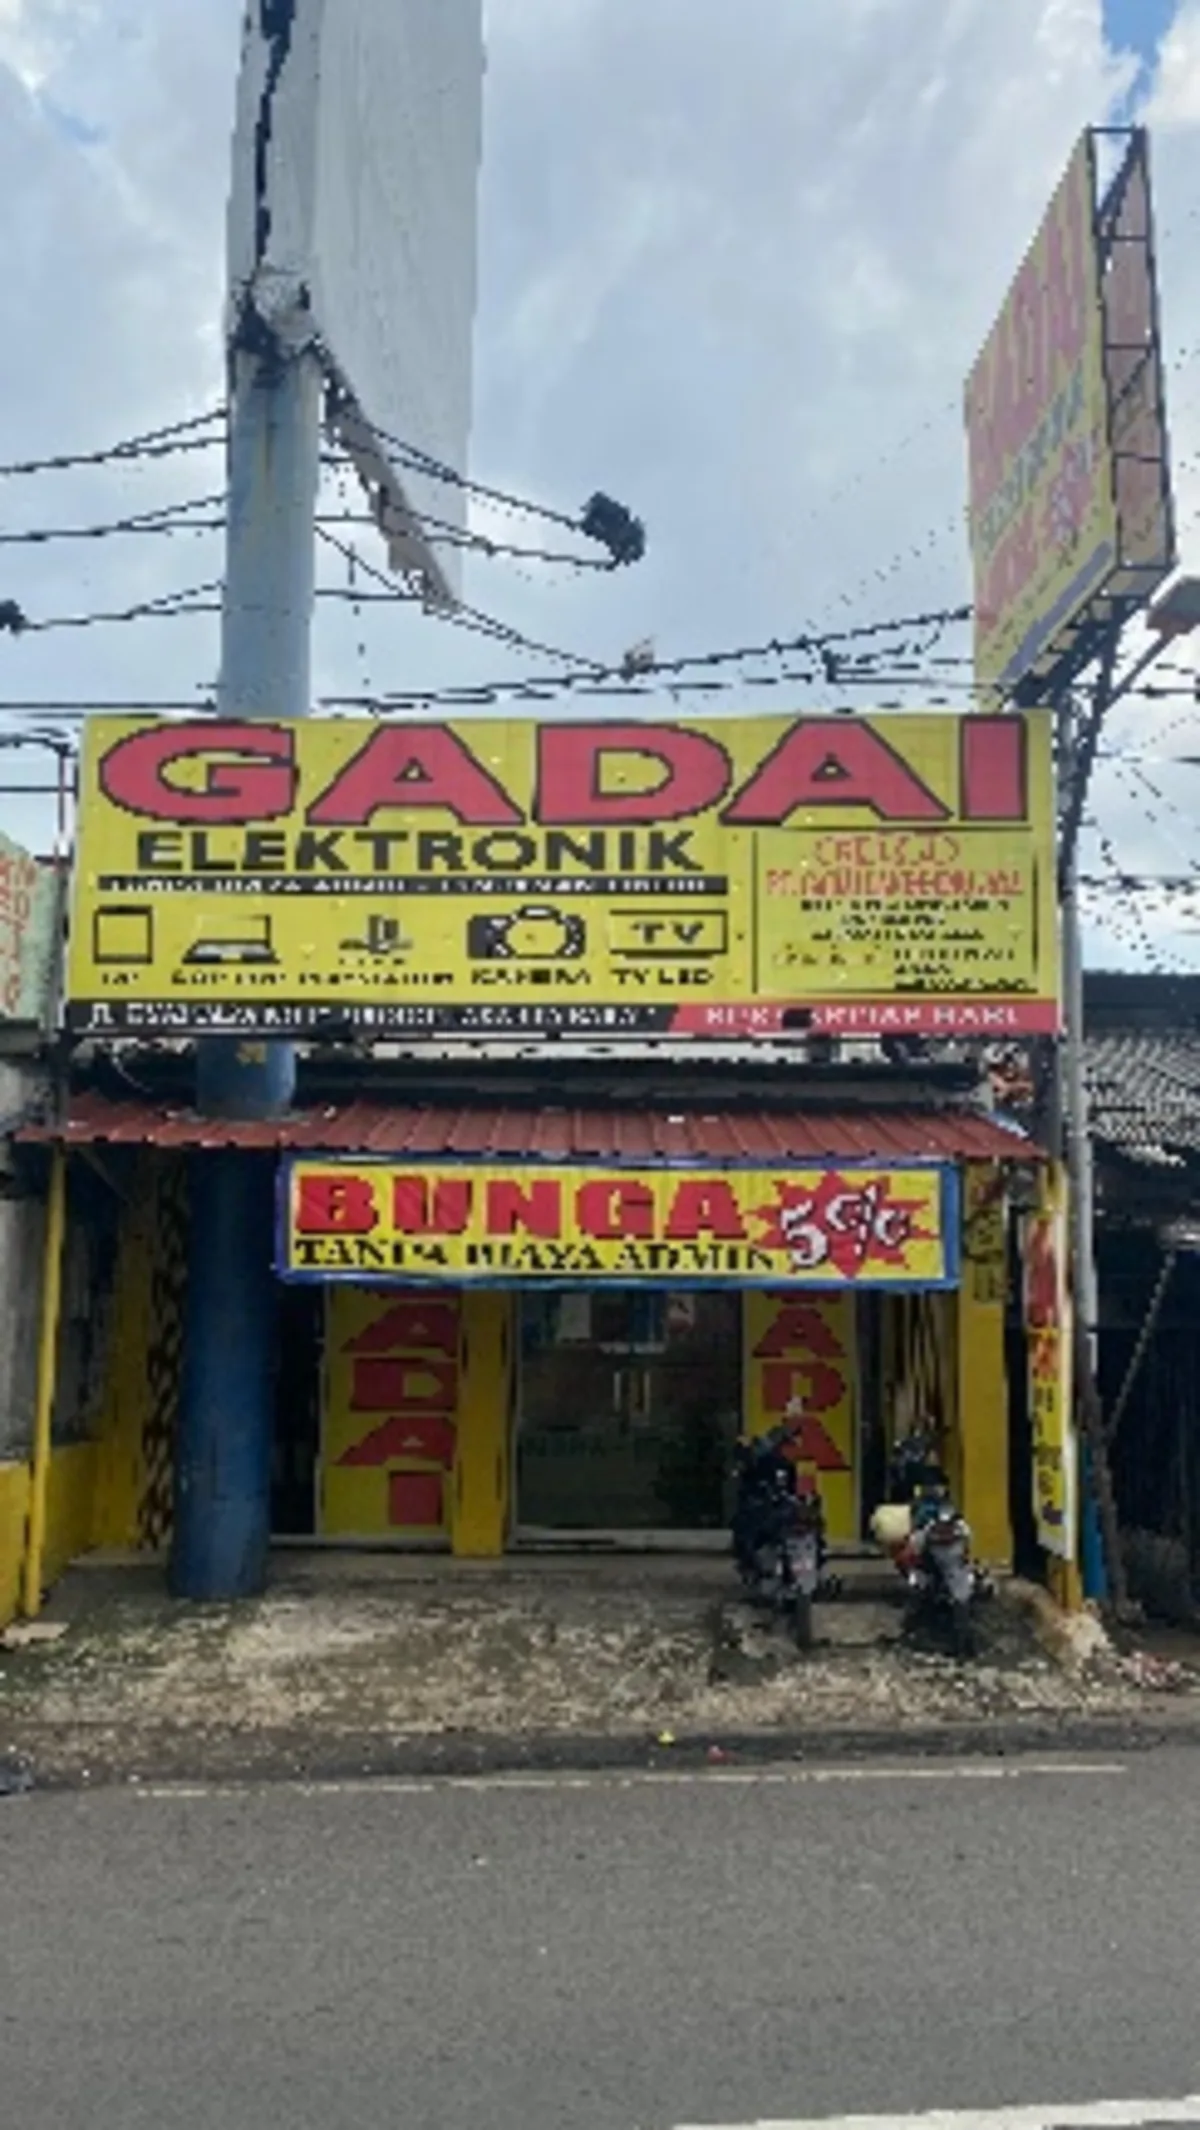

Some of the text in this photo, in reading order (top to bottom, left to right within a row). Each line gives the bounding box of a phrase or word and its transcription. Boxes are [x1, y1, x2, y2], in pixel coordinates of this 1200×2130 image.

[99, 715, 1028, 826] GADAI
[137, 830, 703, 871] ELEKTRONIK
[631, 920, 704, 944] TV
[657, 968, 715, 985] LED
[294, 1174, 749, 1241] BUNGA
[779, 1184, 909, 1268] 5%
[294, 1239, 448, 1267] TANPA
[614, 1242, 775, 1271] ADMIN
[335, 1288, 460, 1526] ADAI
[752, 1290, 852, 1497] ADA
